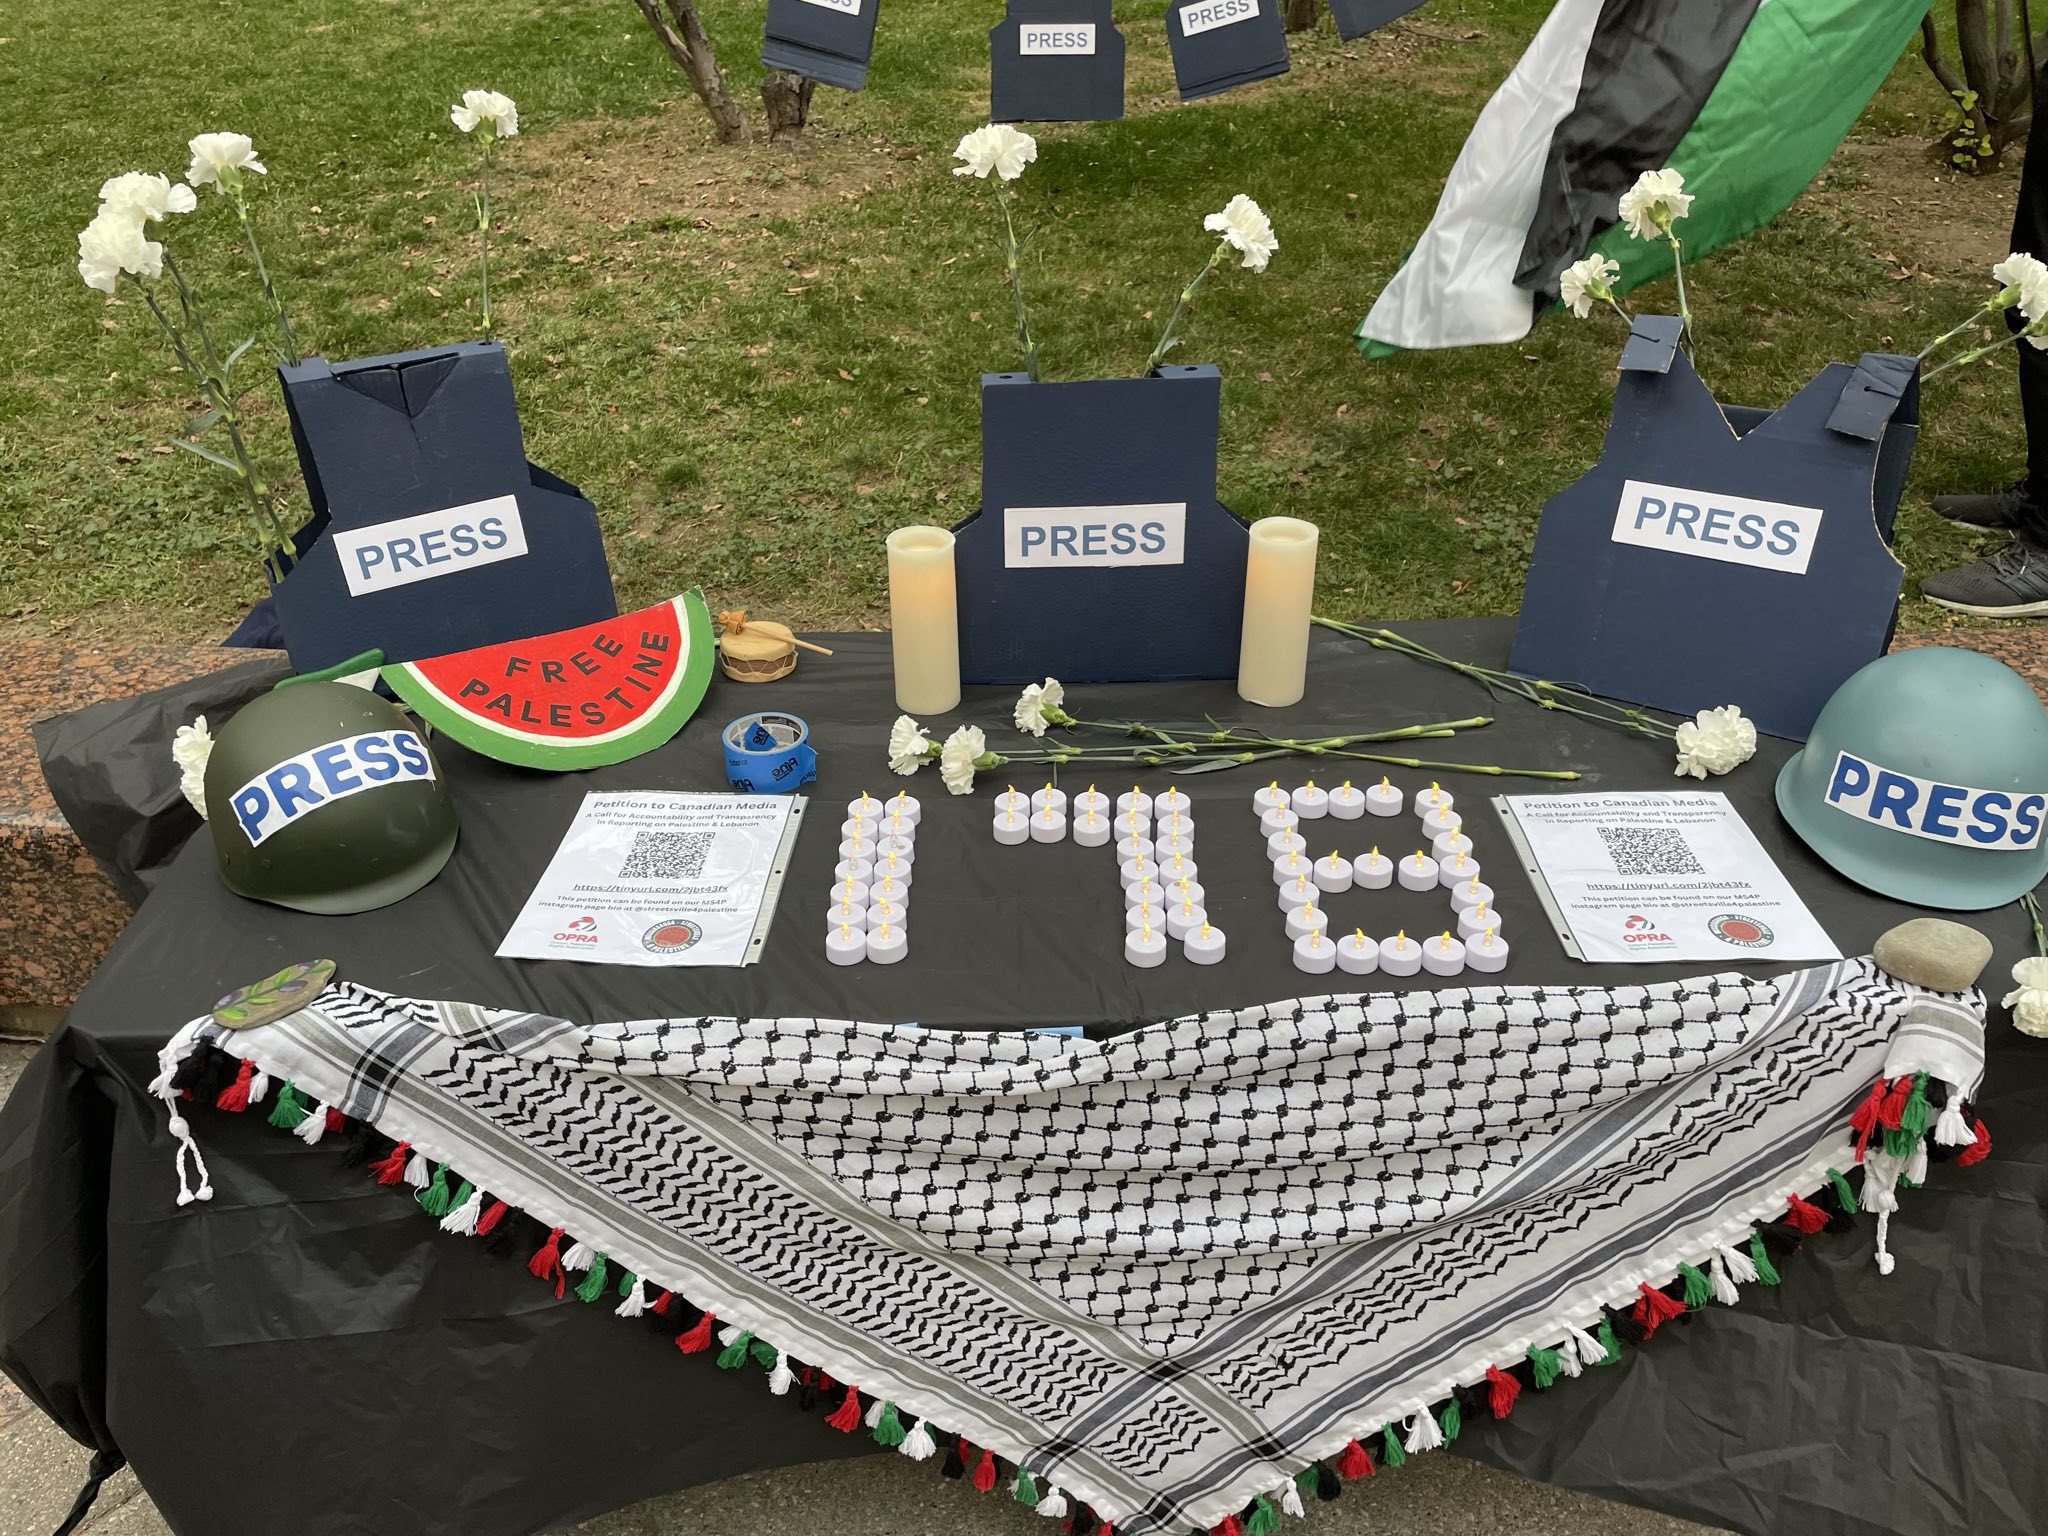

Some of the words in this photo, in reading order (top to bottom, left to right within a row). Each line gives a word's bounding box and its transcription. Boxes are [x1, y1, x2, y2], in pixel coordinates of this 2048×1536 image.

[1188, 0, 1251, 29] PRESS
[1027, 33, 1088, 48] PRESS
[1021, 522, 1166, 557] PRESS
[1633, 496, 1801, 557] PRESS
[355, 518, 509, 580] PRESS
[506, 633, 624, 685] FREE
[458, 631, 670, 728] PALESTINE
[234, 733, 429, 841] PRESS
[1828, 754, 2046, 845] PRESS
[594, 800, 647, 809] Petition
[669, 802, 732, 810] Canadian
[628, 813, 695, 821] Accountability
[1603, 799, 1670, 807] Canadian
[1673, 799, 1718, 807] Media
[608, 820, 652, 828] Reporting
[553, 933, 598, 943] OPRA
[1623, 933, 1673, 943] OPRA
